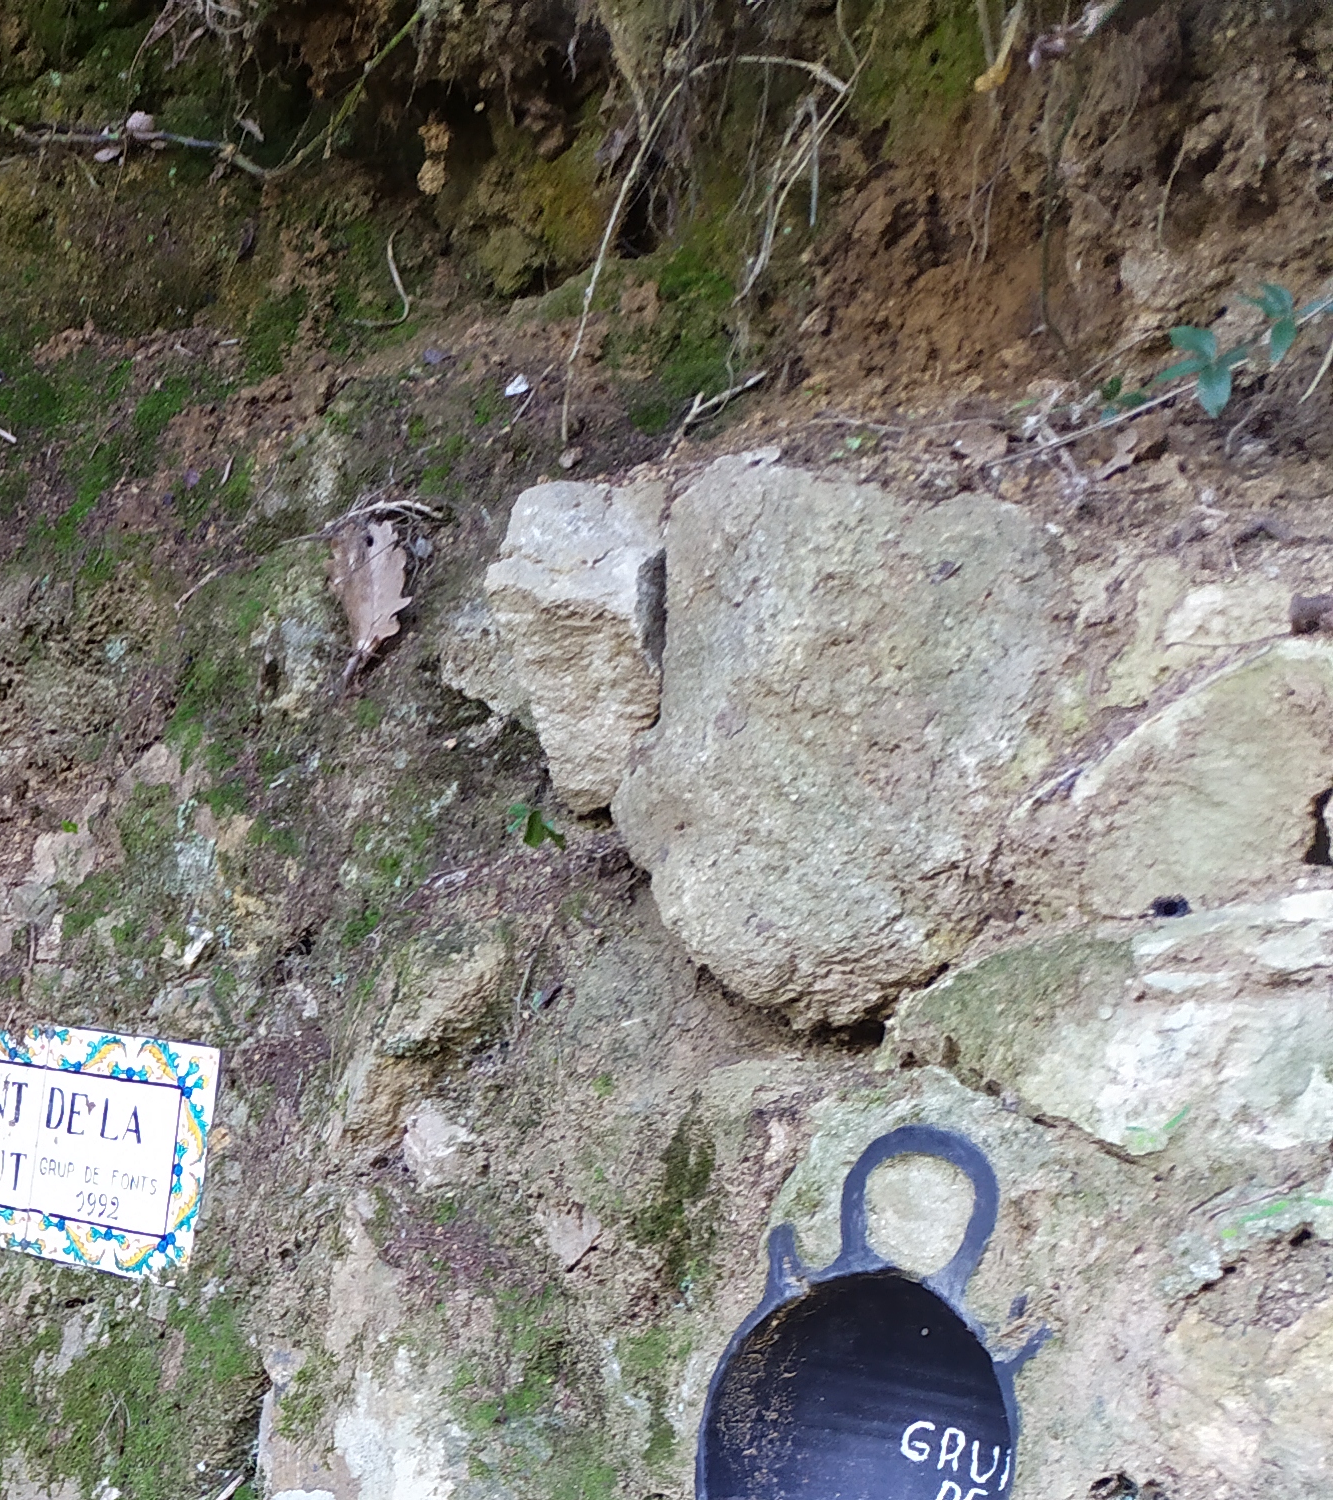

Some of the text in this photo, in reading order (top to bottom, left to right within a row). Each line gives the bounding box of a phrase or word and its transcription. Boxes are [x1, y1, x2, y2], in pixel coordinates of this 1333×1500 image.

[45, 1087, 89, 1136] DE
[100, 1098, 142, 1144] LA
[38, 1157, 159, 1196] GRUP DE FONTS
[76, 1190, 121, 1221] 1992
